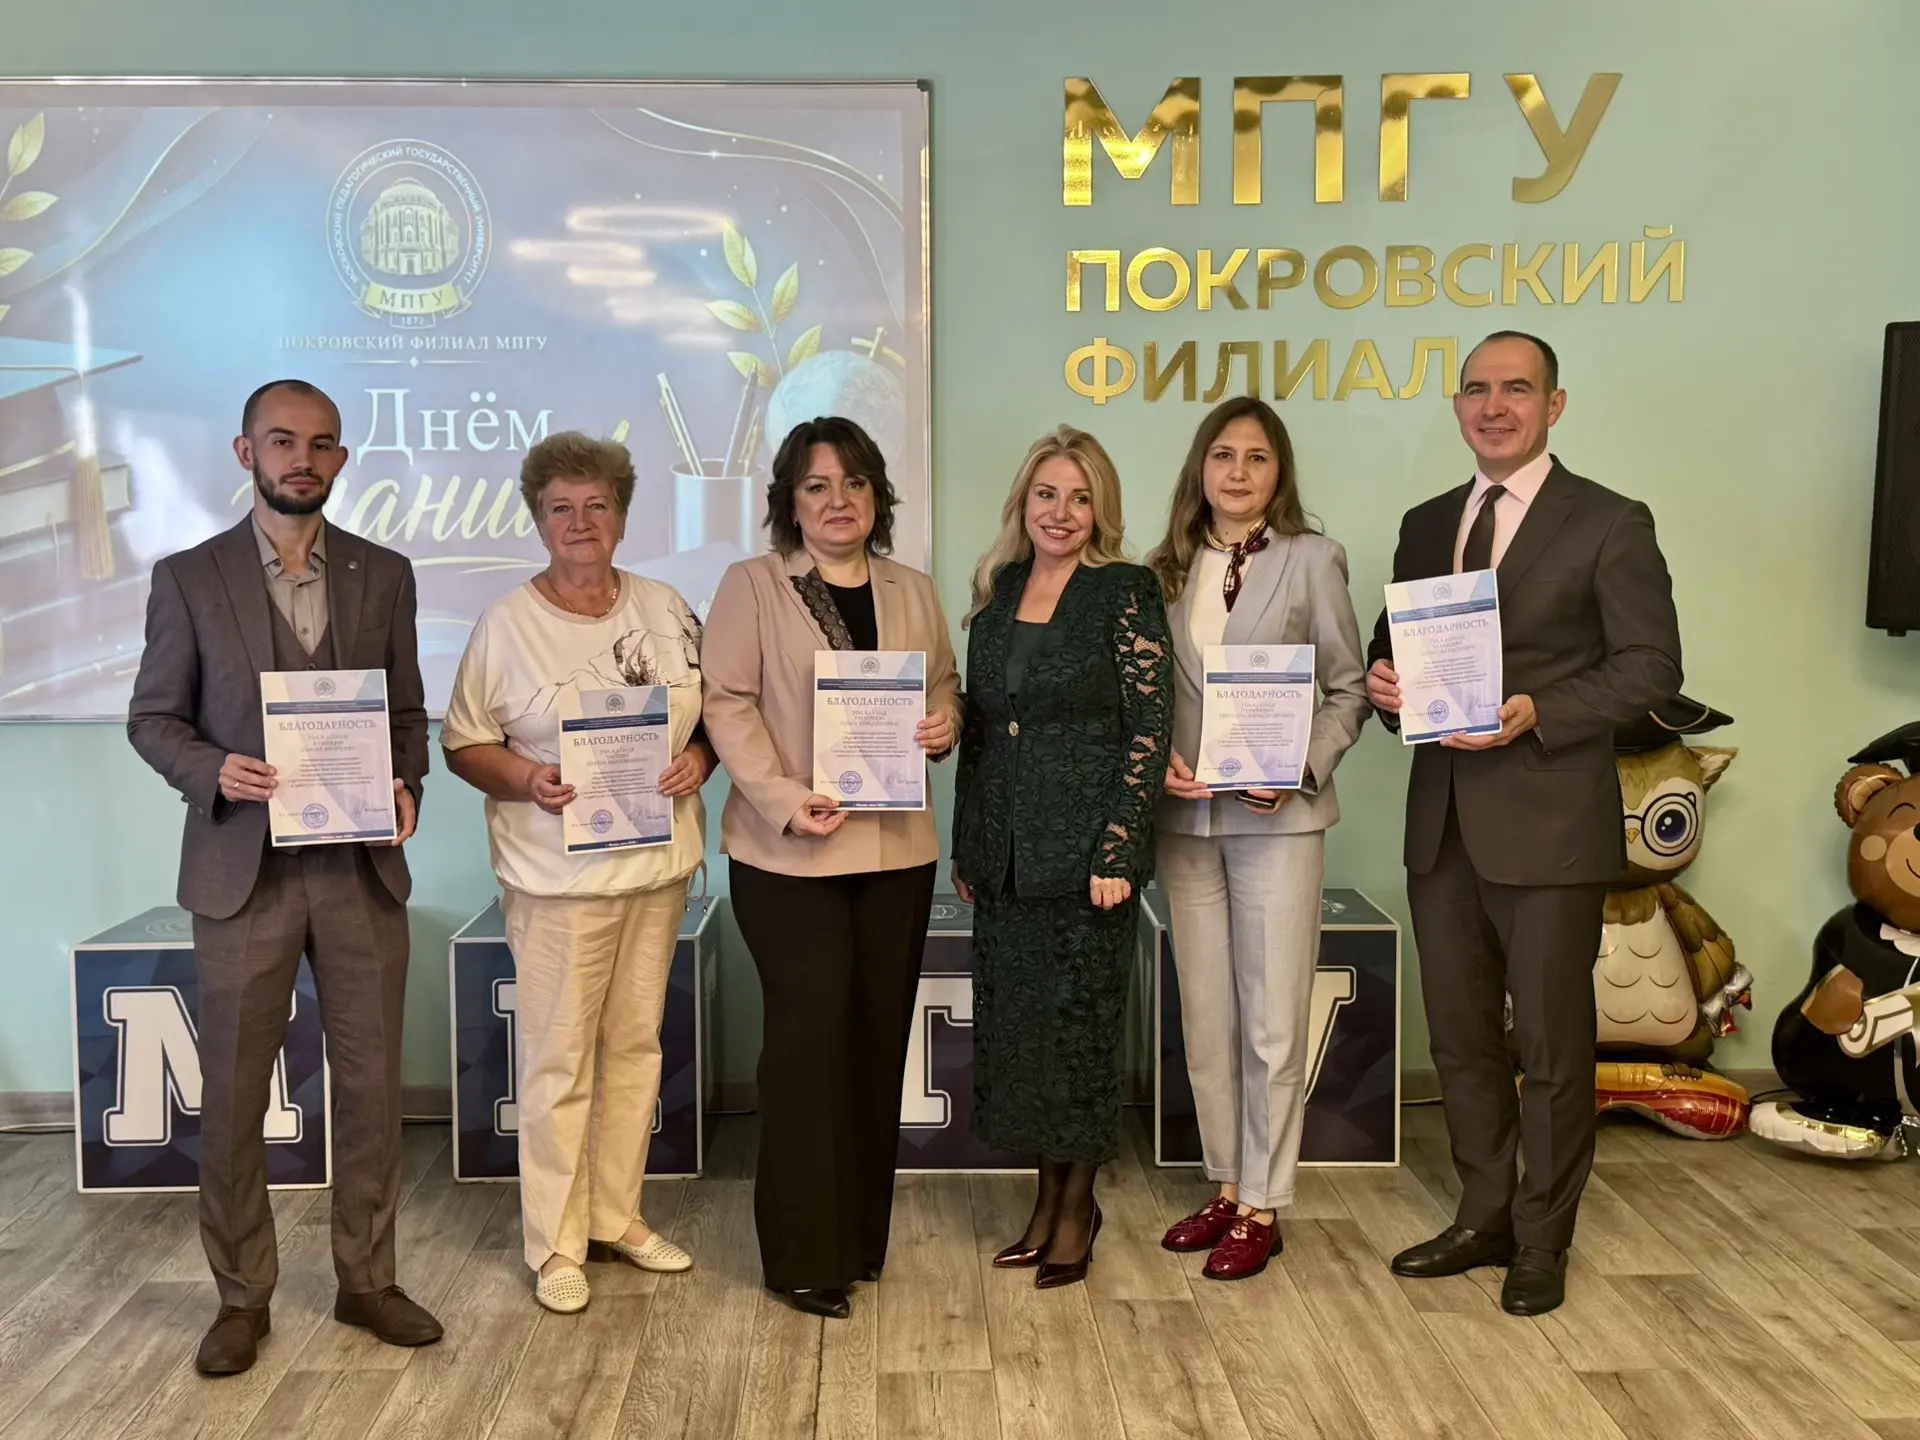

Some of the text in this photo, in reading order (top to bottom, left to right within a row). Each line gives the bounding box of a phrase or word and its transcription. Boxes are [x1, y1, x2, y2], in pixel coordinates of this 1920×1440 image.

[1063, 72, 1623, 205] МПГУ
[1066, 224, 1685, 311] ПОКРОВСКИЙ
[379, 288, 444, 309] МПГУ
[278, 334, 548, 351] ПОКРОВСКИЙ ФИЛИАЛ МПГУ
[1064, 336, 1459, 404] ФИЛИАЛ
[356, 387, 554, 467] Днём
[1403, 617, 1489, 638] БЛАГОДАРНОСТЬ
[827, 696, 914, 706] БЛАГОДАРНОСТЬ
[1216, 689, 1302, 699] БЛАГОДАРНОСТЬ
[278, 718, 377, 731] БЛАГОДАРНОСТЬ
[573, 732, 660, 747] БЛАГОДАРНОСТЬ
